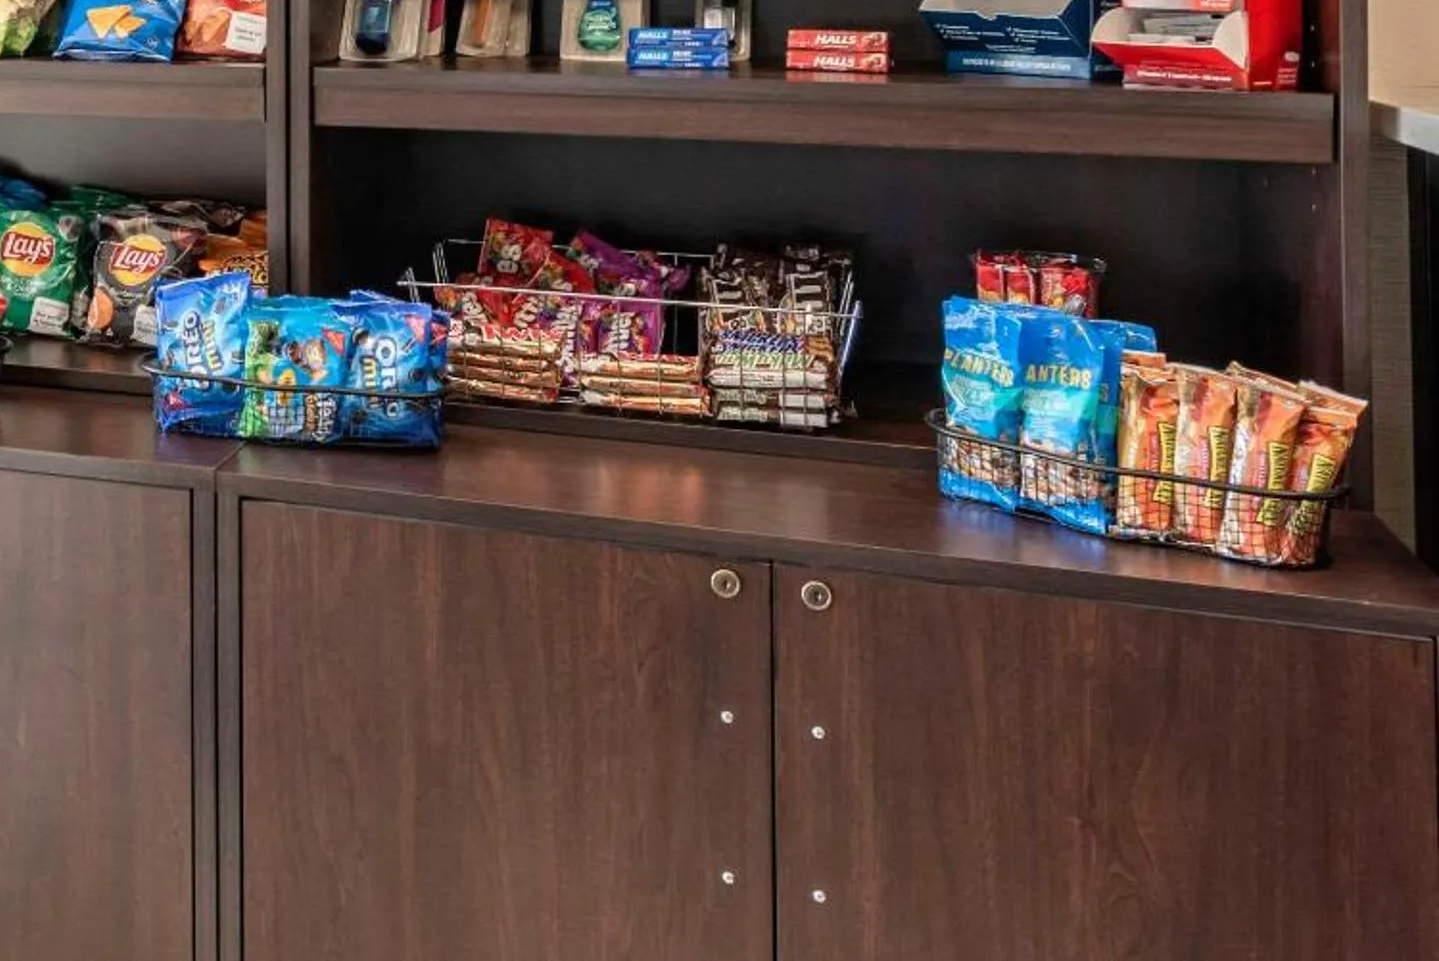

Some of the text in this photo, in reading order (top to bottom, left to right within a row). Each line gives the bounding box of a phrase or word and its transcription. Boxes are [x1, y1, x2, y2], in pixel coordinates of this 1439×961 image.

[815, 34, 857, 45] HALLS
[813, 56, 855, 67] HALLS
[374, 337, 399, 418] ORO
[944, 348, 1014, 387] PLANTER
